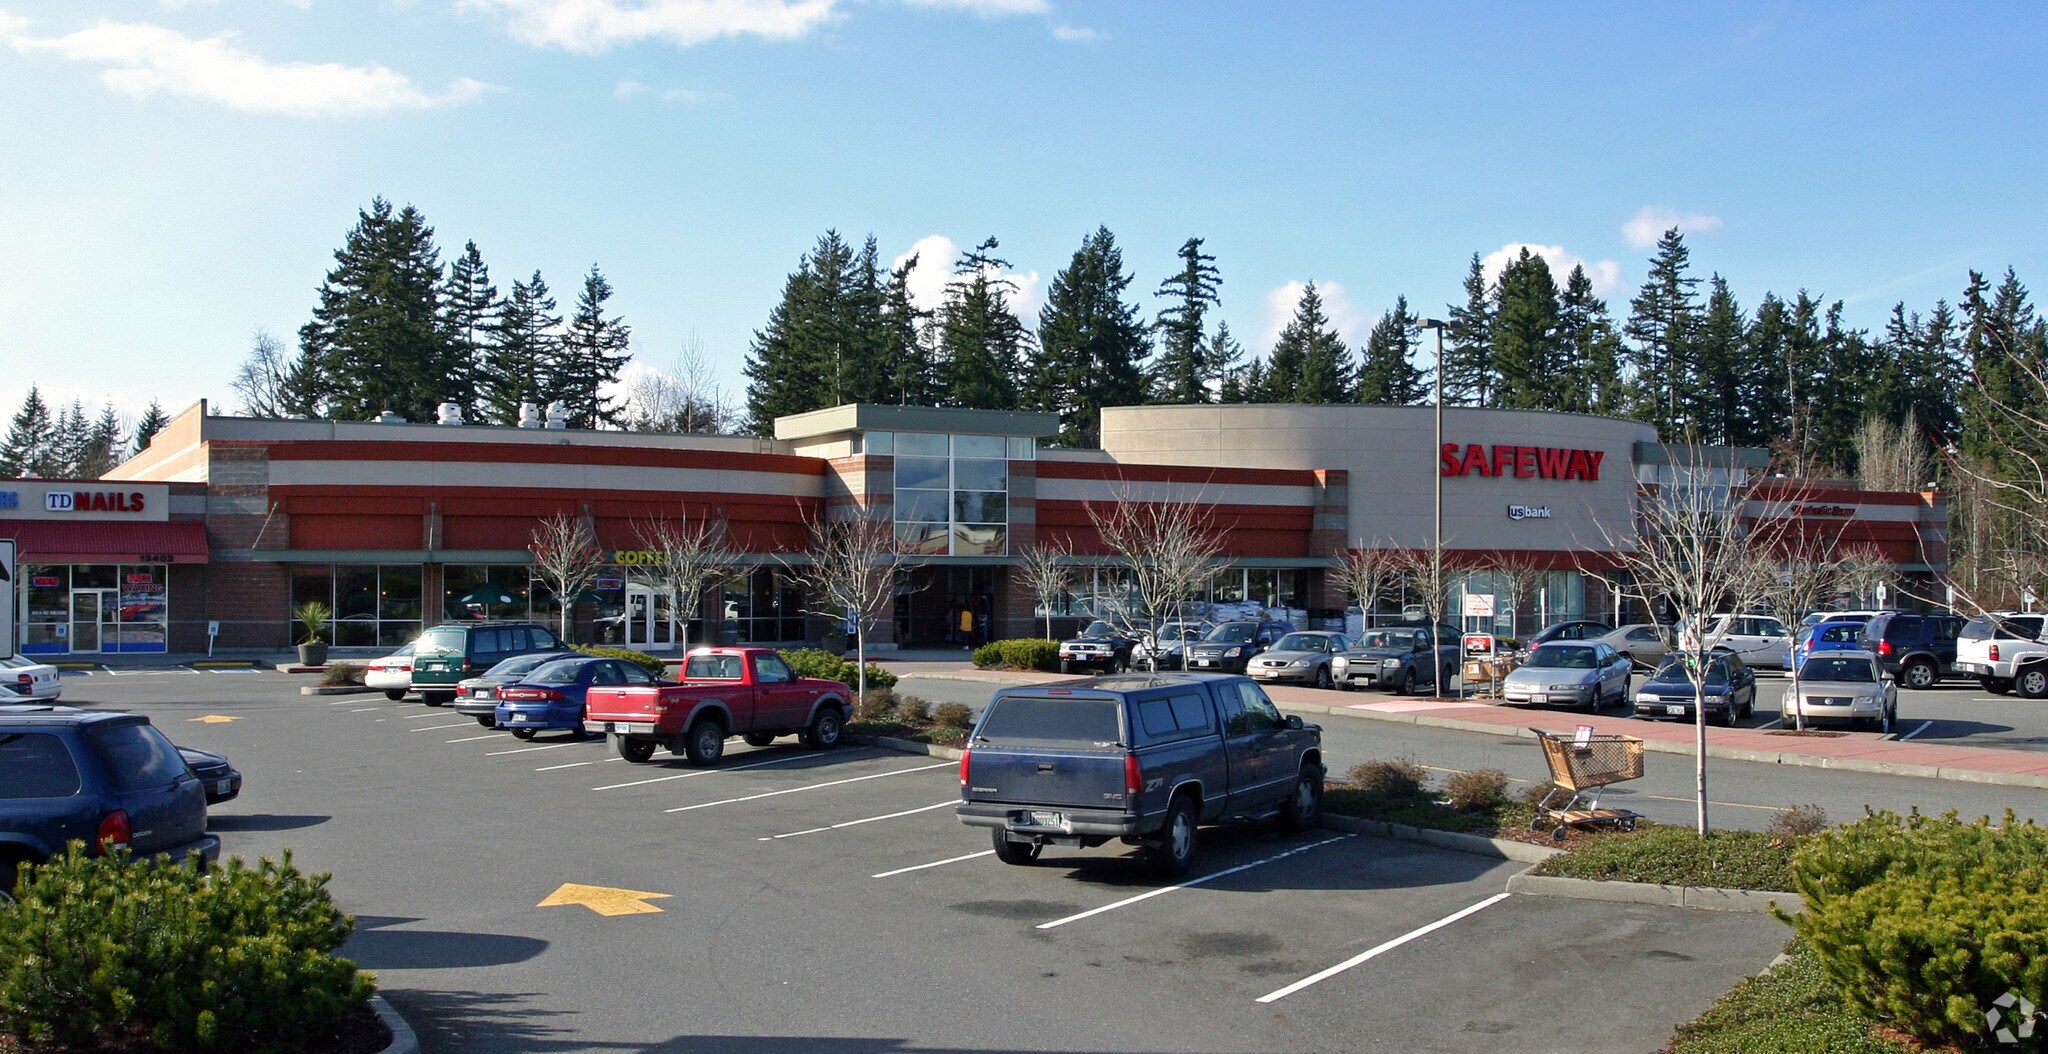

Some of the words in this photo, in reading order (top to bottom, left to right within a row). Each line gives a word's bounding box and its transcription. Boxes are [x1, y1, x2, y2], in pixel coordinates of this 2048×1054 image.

[1440, 443, 1605, 481] SAFEWAY
[48, 494, 72, 508] TD
[75, 492, 144, 511] NAILS
[1511, 506, 1523, 517] us
[1525, 506, 1551, 518] bank
[122, 583, 164, 592] WAXING
